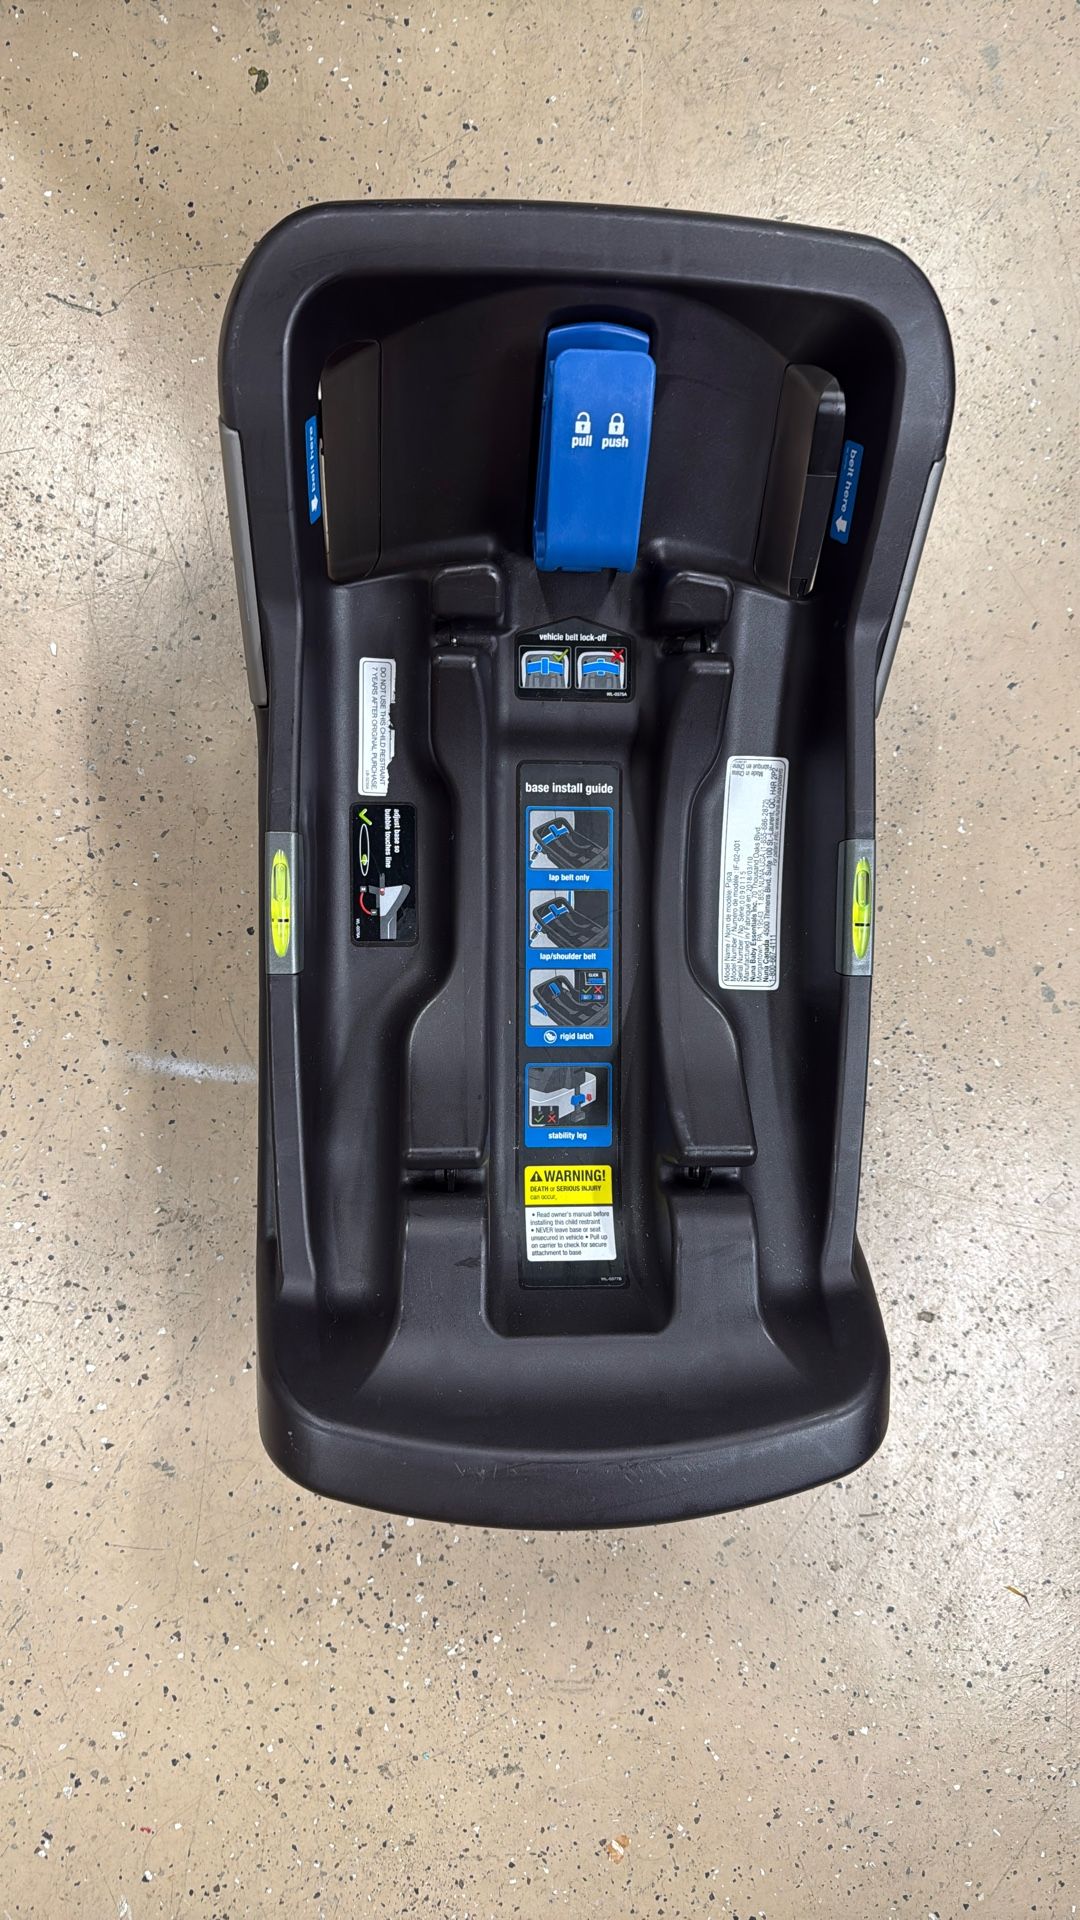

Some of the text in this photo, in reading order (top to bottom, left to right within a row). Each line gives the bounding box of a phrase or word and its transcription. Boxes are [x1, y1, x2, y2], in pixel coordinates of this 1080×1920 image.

[572, 435, 629, 450] pull push
[847, 449, 857, 477] belt
[841, 481, 852, 512] here
[539, 633, 607, 642] vehicle belt lock-off
[380, 667, 386, 678] DO
[526, 782, 613, 795] base install guide
[549, 874, 559, 882] lap
[576, 874, 590, 882] only
[540, 952, 581, 961] lap/shoulder
[560, 1031, 594, 1040] rigid latch
[548, 1131, 587, 1140] stability leg
[544, 1169, 606, 1181] WARNING!
